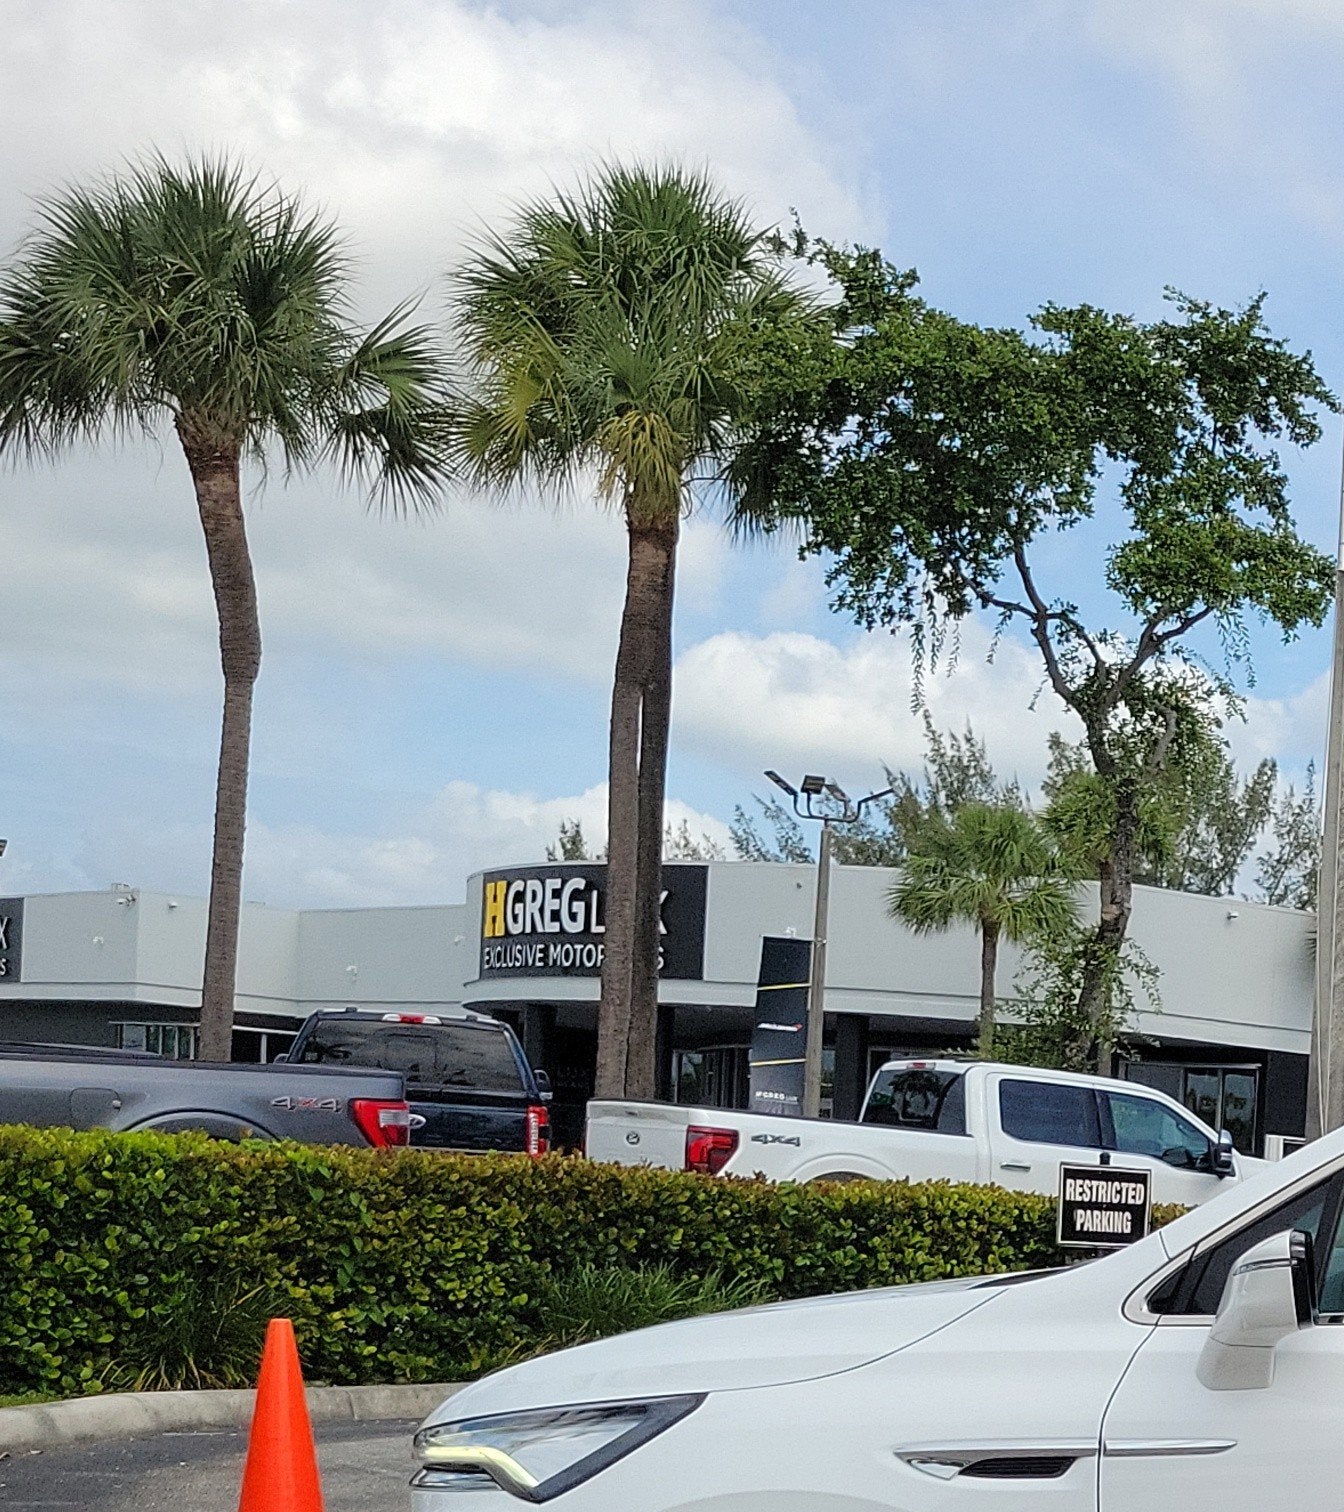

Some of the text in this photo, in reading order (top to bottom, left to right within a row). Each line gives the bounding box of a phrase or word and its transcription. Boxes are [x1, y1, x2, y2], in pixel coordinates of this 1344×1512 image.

[484, 877, 669, 938] HGREGL
[484, 944, 544, 970] EXCLUSIVE
[1065, 1178, 1145, 1205] RESTRICTED
[1075, 1209, 1132, 1234] PARKING
